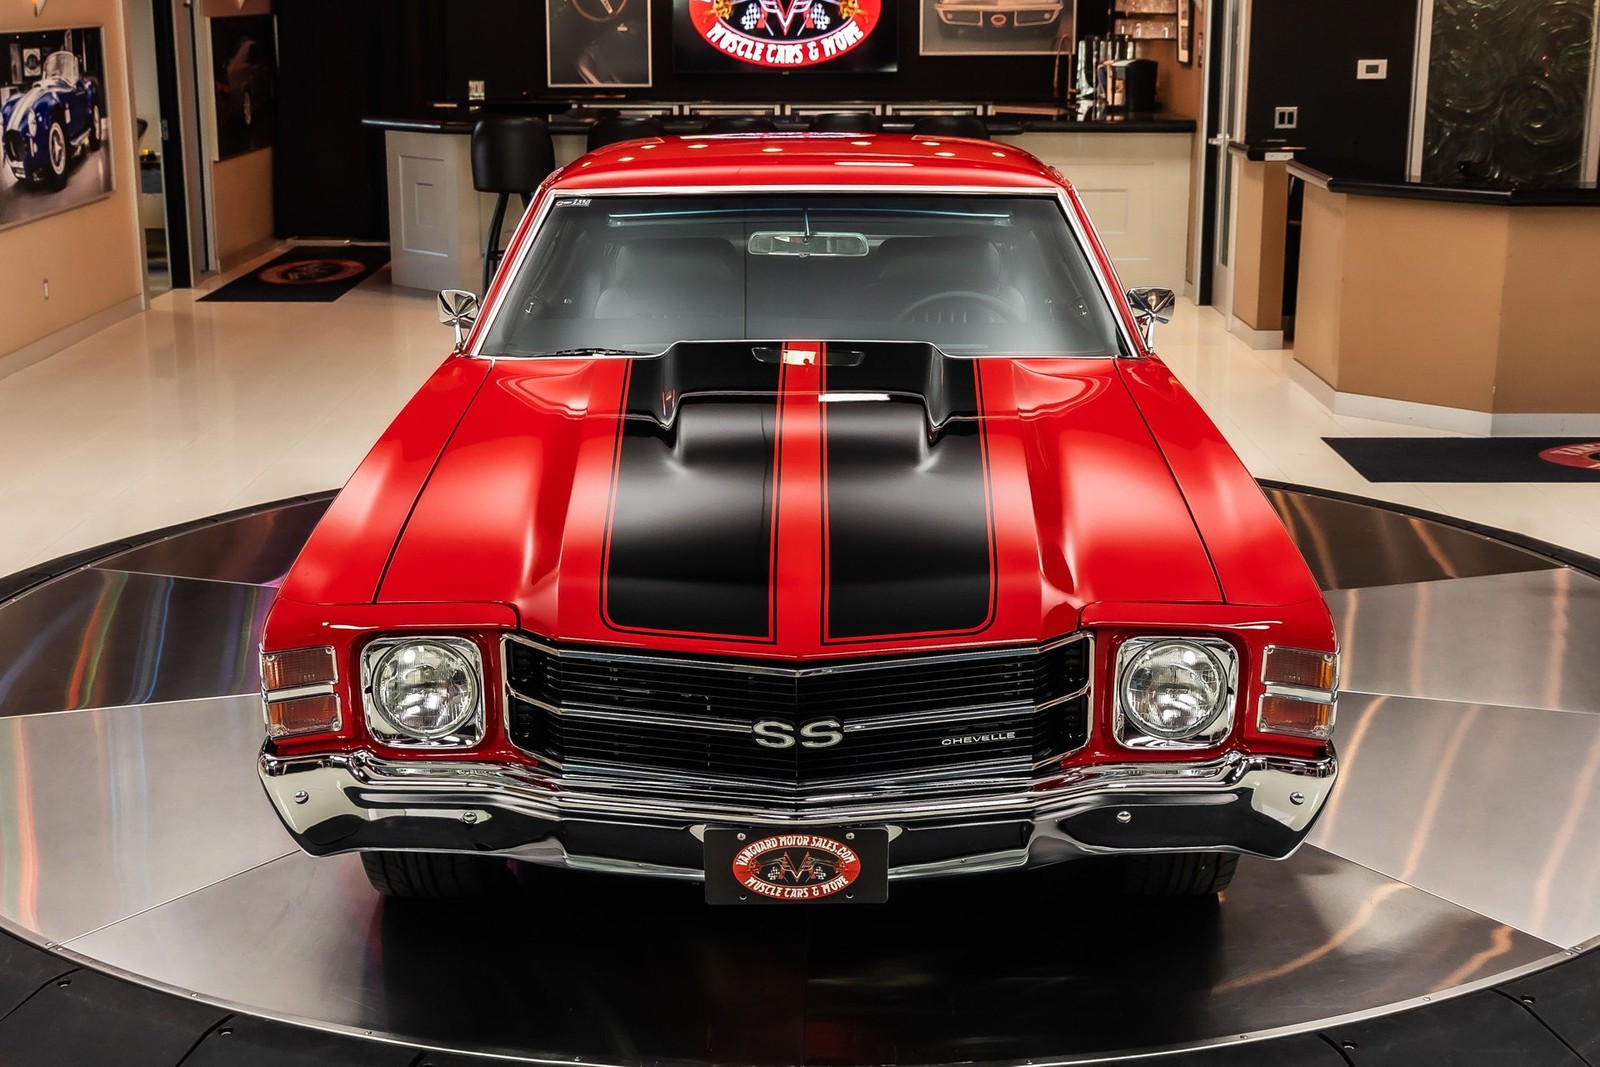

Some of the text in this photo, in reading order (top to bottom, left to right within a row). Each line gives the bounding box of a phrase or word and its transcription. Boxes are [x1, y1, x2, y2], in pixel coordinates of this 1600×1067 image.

[706, 20, 864, 64] MUSCLE CARS & MORE
[752, 720, 843, 748] SS
[941, 732, 1016, 746] CHEVELLE
[736, 835, 856, 866] VANGUARD MOTOR SALES.COM
[744, 876, 849, 898] MUSCLE CARS & MORE
